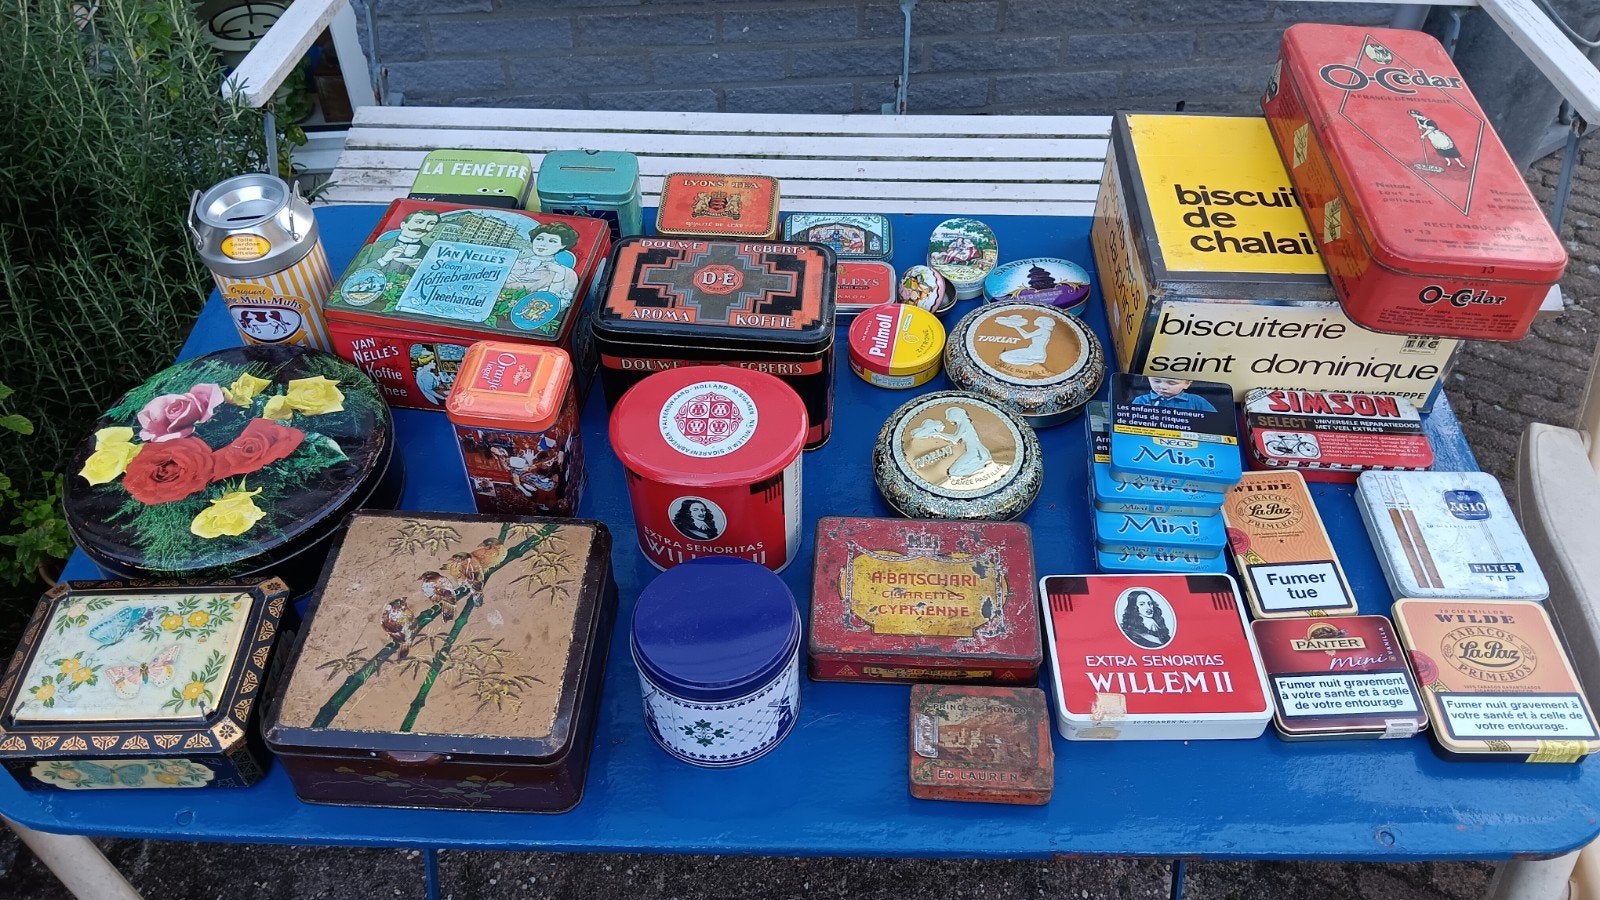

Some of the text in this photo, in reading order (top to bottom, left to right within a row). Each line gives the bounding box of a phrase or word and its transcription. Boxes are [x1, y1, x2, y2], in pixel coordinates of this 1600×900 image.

[1318, 63, 1463, 95] O-Cedar
[422, 161, 529, 182] LA FENÊTRE
[1183, 207, 1236, 229] de
[436, 246, 461, 259] VAN
[641, 239, 807, 254] DOUWE EGBERTS
[430, 259, 463, 271] Stoom
[994, 258, 1073, 277] SANDELHOLZ
[461, 284, 475, 292] en
[425, 284, 487, 308] Theehandel
[1418, 285, 1507, 308] O-Cedar
[629, 309, 795, 328] AROMA KOFFIE
[1159, 313, 1346, 341] biscuiterie
[868, 313, 893, 357] Pulmoll
[977, 335, 1022, 344] TJOKLAT
[351, 337, 375, 351] VAN
[366, 361, 404, 384] Koffie
[621, 358, 803, 374] DOUWE EGBERTS
[1149, 353, 1439, 382] saint dominique
[1268, 391, 1400, 417] SIMSON
[1131, 405, 1159, 414] enfants
[1173, 409, 1205, 418] fumeurs
[1132, 412, 1148, 420] plus
[1161, 415, 1189, 424] risques
[1128, 419, 1158, 427] devenir
[1159, 421, 1192, 431] fumeurs
[1258, 416, 1307, 428] SELECT
[1132, 445, 1216, 469] Mini
[1235, 483, 1292, 492] WILDE
[1249, 503, 1291, 516] La Paz
[1450, 501, 1486, 512] AGIO
[1118, 515, 1200, 535] Mini
[644, 526, 764, 554] EXTRA SENORITAS
[1474, 564, 1518, 573] FILTER
[1267, 573, 1326, 585] Fumer
[882, 590, 965, 600] CIGARETTES
[1287, 588, 1318, 599] tue
[1435, 614, 1515, 624] WILDE
[1448, 627, 1514, 642] TABACOS
[1296, 639, 1360, 650] PANTER
[1459, 640, 1520, 659] La Paz
[1085, 654, 1224, 667] EXTRA SENORITAS
[1458, 664, 1532, 681] PRIMEROS
[1085, 671, 1234, 694] WILLEM II
[1280, 677, 1405, 690] Fumer nuit gravement
[1282, 687, 1410, 700] à votre santé et à celle
[1295, 698, 1404, 710] de votre entourage
[1447, 701, 1579, 710] Fumer nuit gravement à
[1451, 710, 1583, 720] votre santé et à celle de
[1475, 722, 1568, 731] votre entourage.
